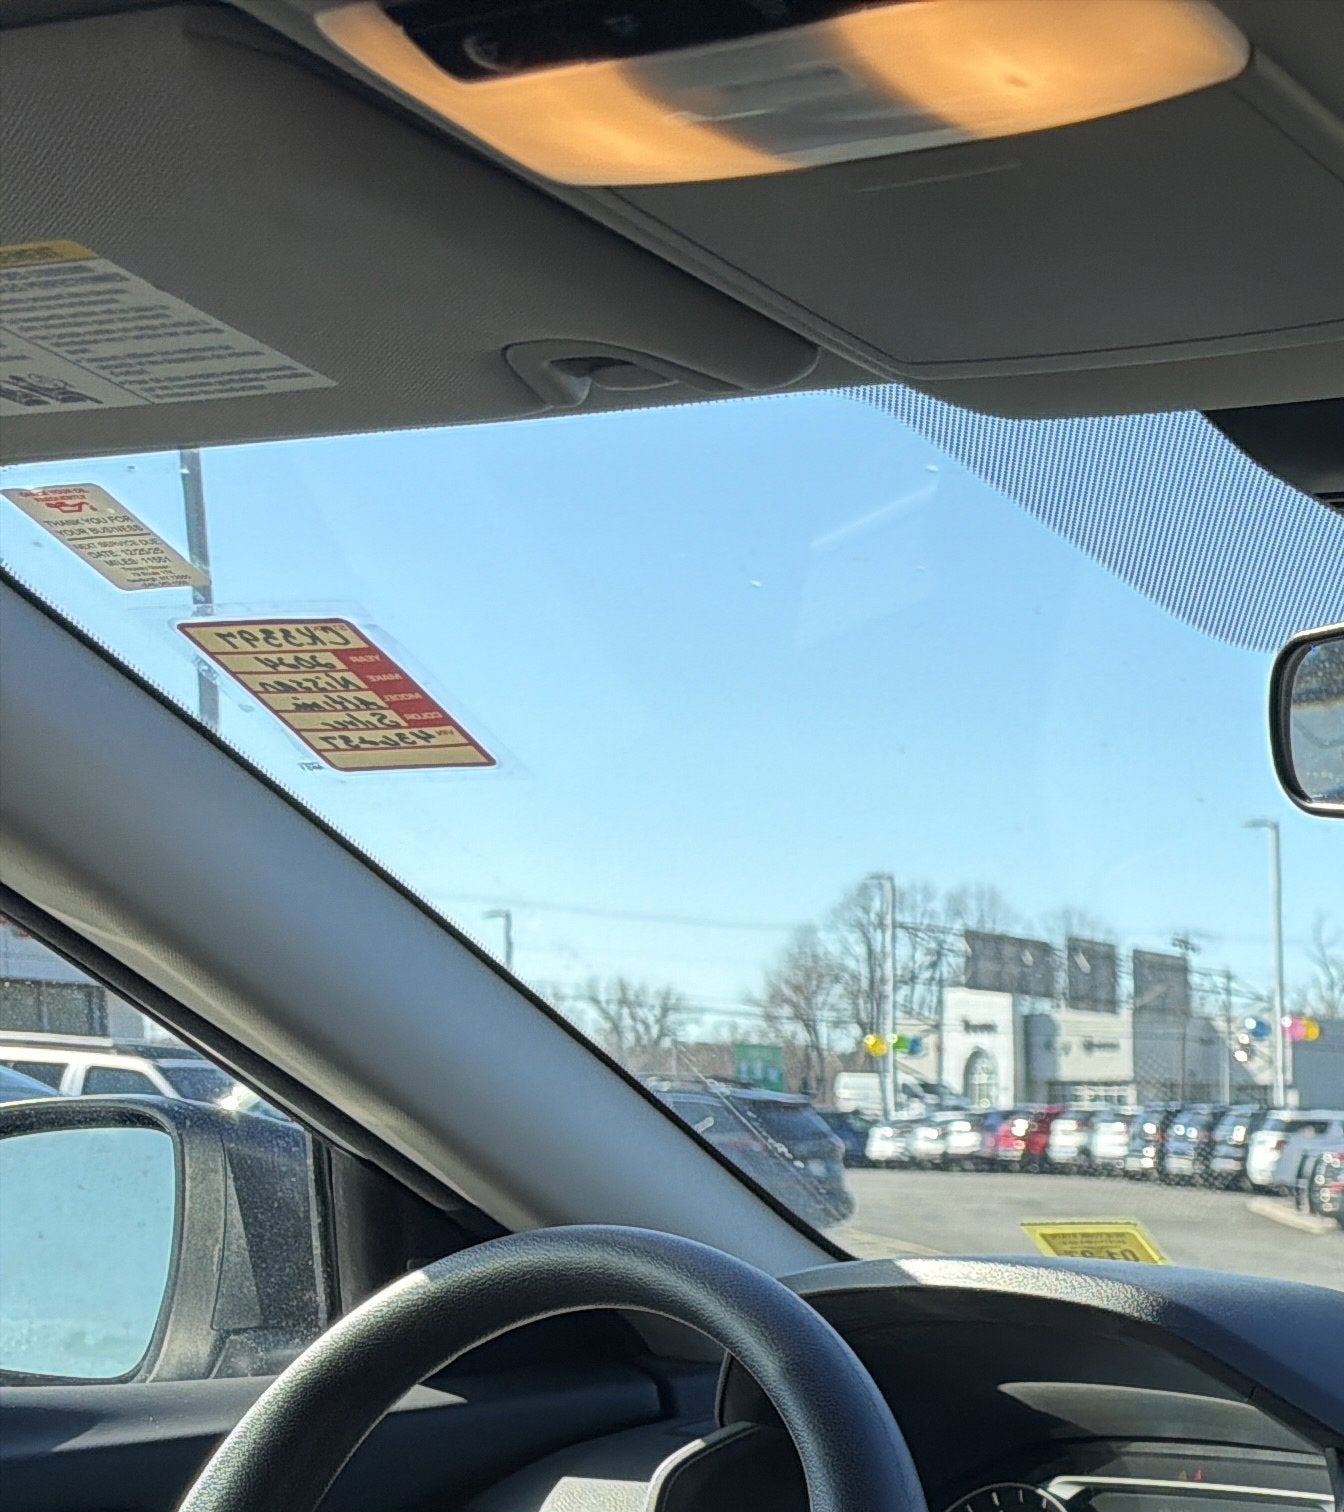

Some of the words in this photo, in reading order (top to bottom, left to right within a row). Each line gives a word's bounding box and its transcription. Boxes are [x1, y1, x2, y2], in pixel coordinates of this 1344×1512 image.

[82, 516, 107, 525] YOU
[108, 514, 135, 523] FOR
[54, 528, 87, 537] YOUR
